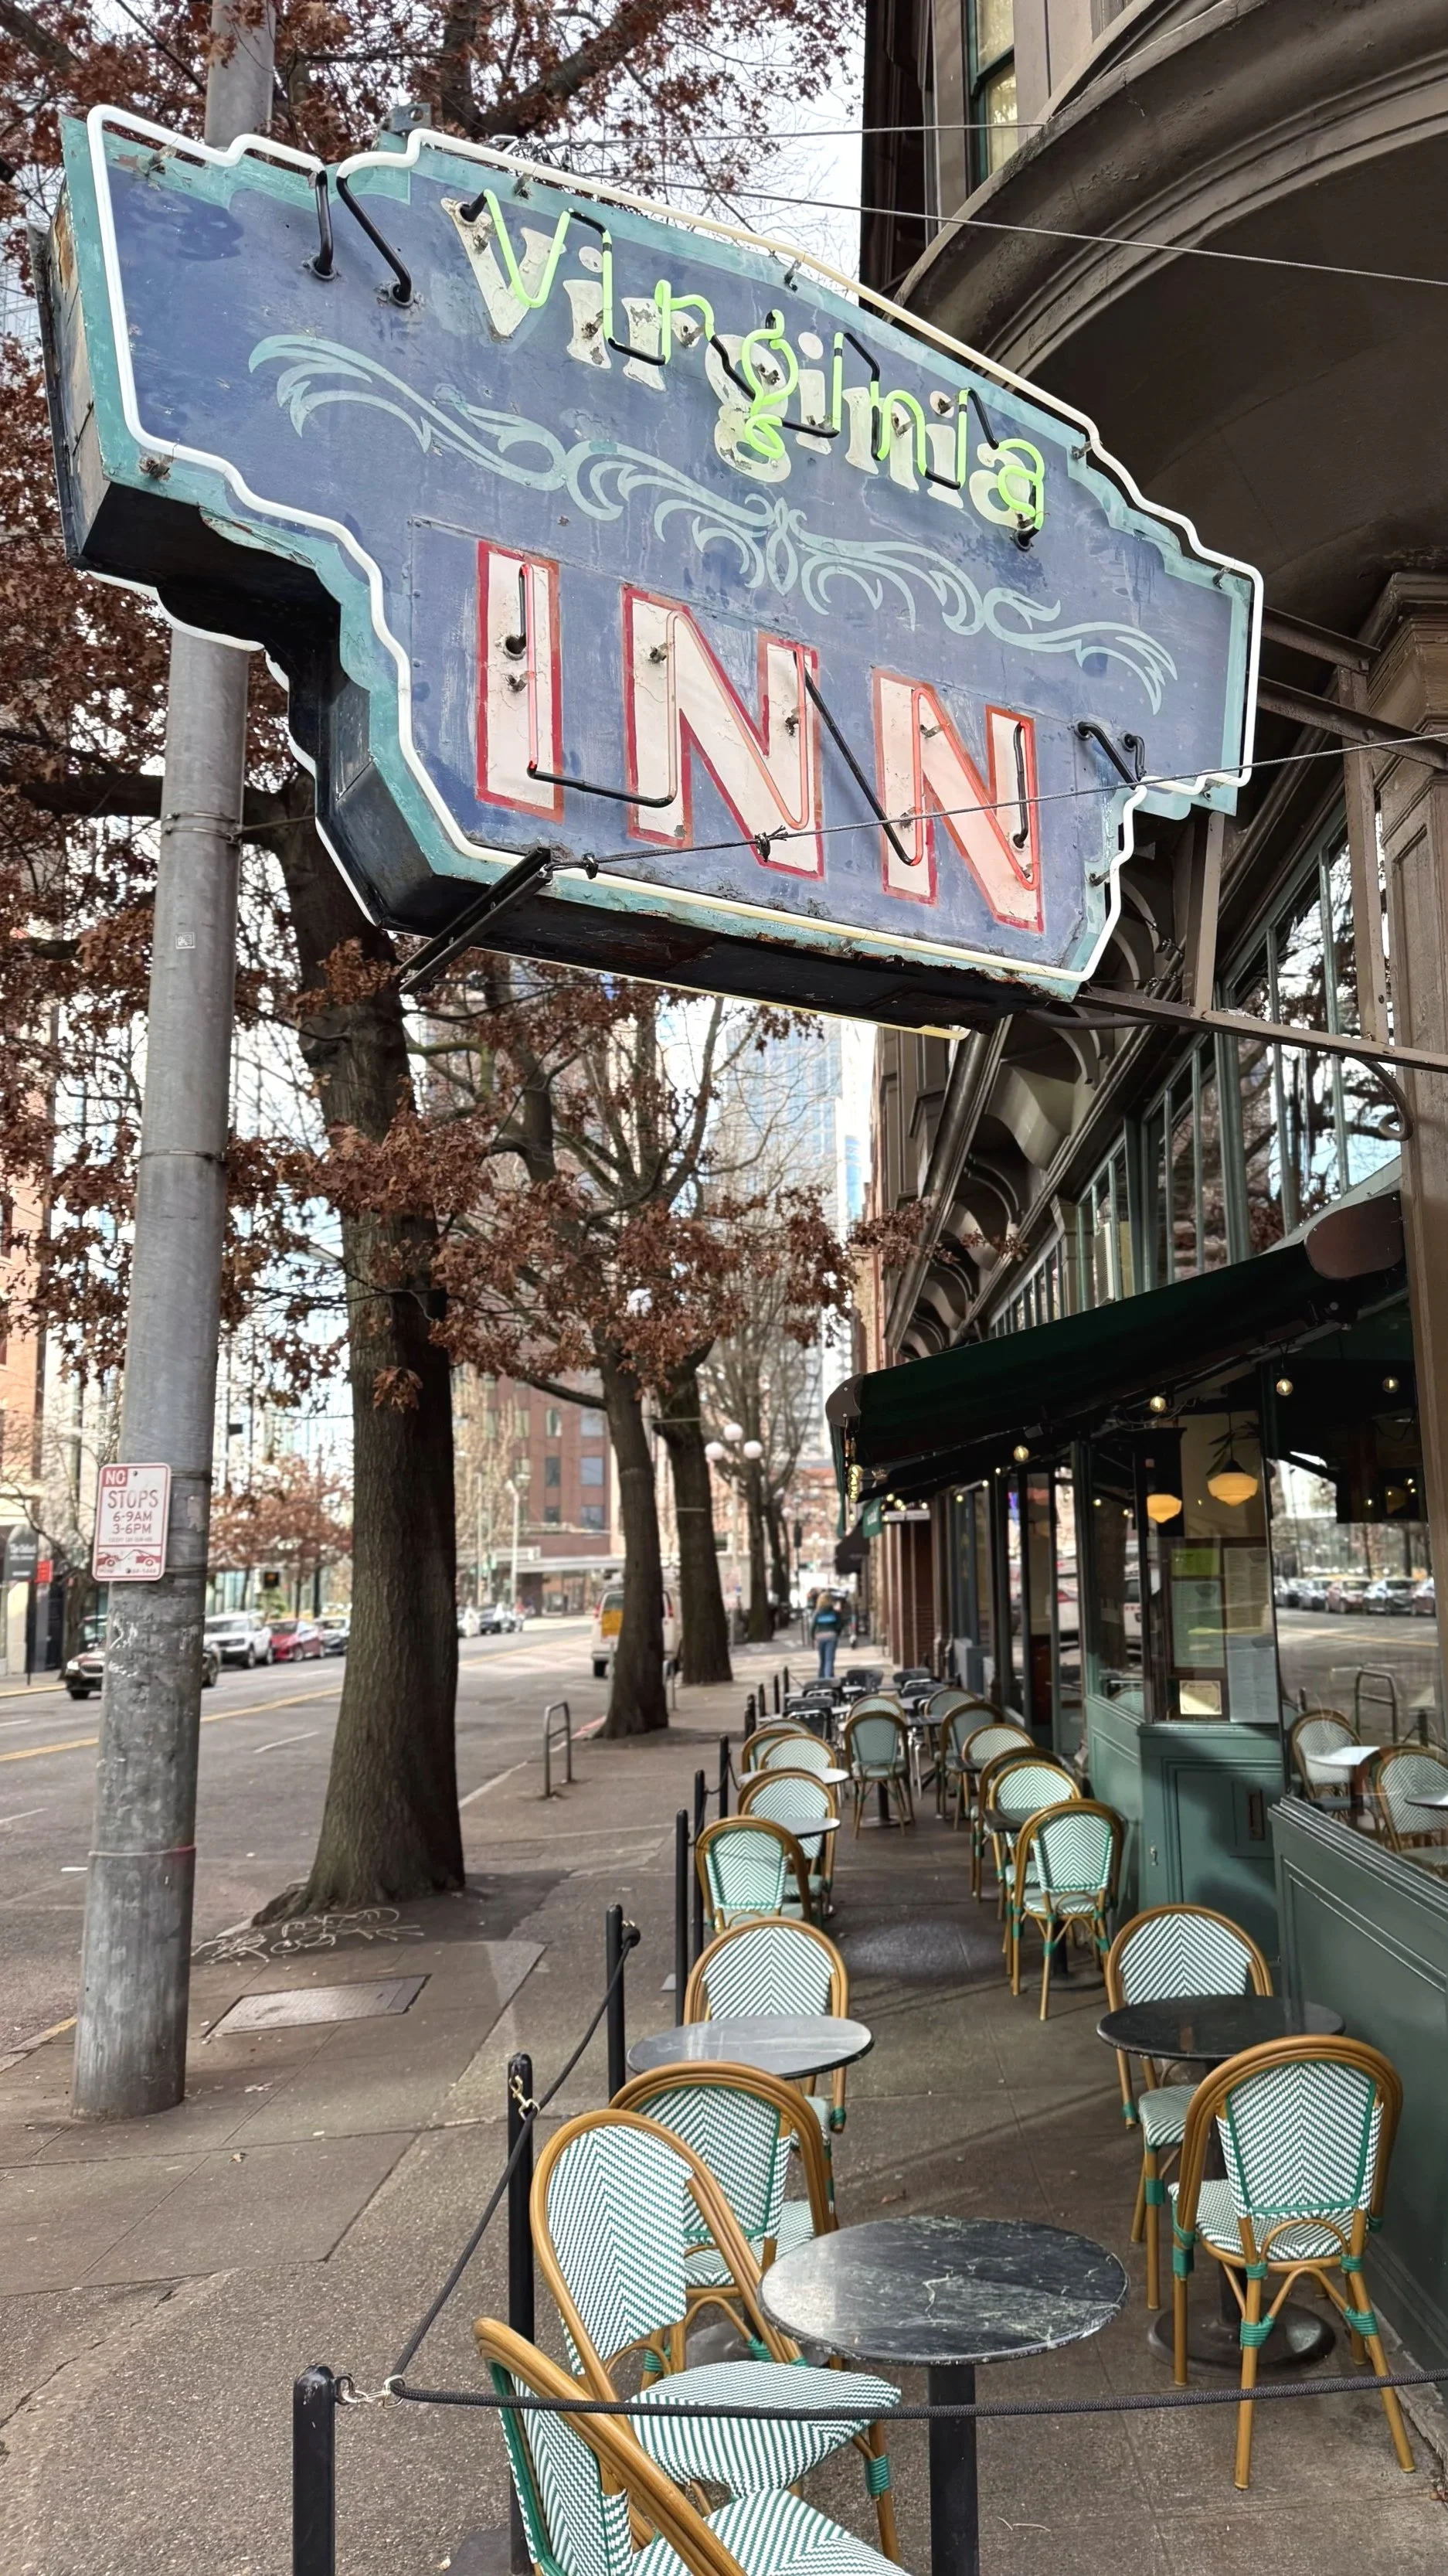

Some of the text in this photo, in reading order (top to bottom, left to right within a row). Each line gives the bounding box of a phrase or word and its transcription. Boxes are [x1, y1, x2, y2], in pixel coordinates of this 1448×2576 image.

[440, 189, 1045, 533] Virginia
[477, 540, 1045, 934] INN
[105, 1470, 126, 1485] NO
[107, 1489, 158, 1509] STOPS
[113, 1512, 152, 1522] 6-9AM
[112, 1524, 151, 1534] 3-6PM
